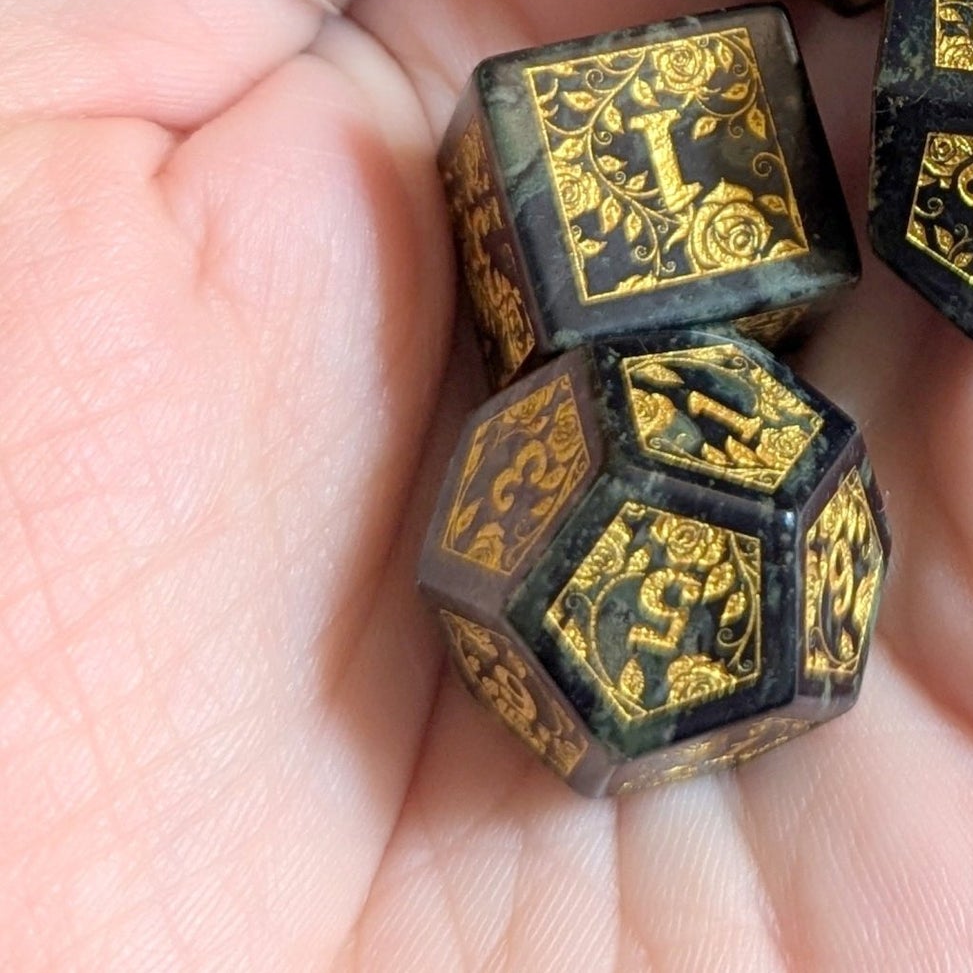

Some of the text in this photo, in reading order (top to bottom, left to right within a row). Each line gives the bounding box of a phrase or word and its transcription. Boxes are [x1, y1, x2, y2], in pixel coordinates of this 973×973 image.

[629, 108, 703, 213] 1
[686, 390, 764, 441] 1
[492, 439, 548, 513] 3
[627, 566, 703, 649] 5
